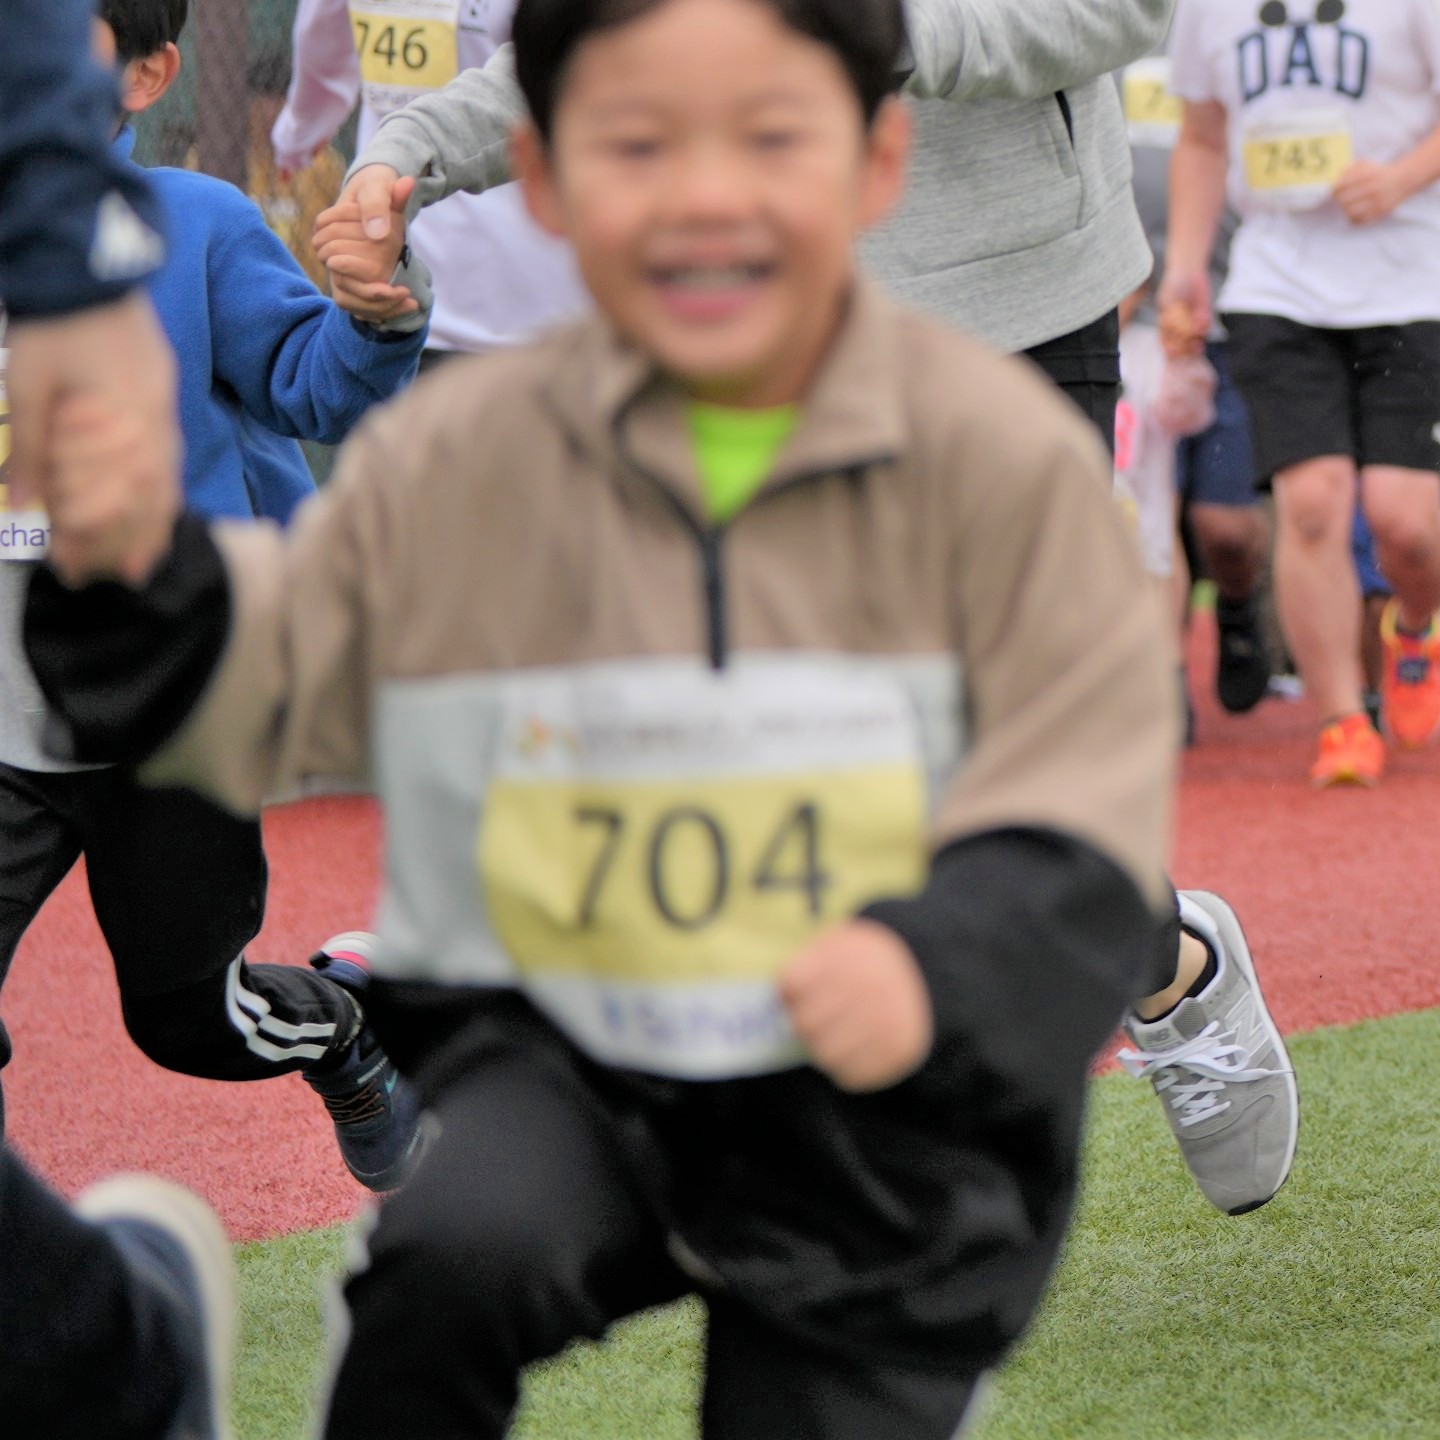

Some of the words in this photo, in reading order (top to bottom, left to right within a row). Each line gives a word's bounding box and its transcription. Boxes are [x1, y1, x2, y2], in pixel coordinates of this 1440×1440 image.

[356, 20, 428, 70] 746
[1236, 20, 1371, 104] DAD
[1262, 137, 1331, 177] 745
[571, 797, 836, 934] 704
